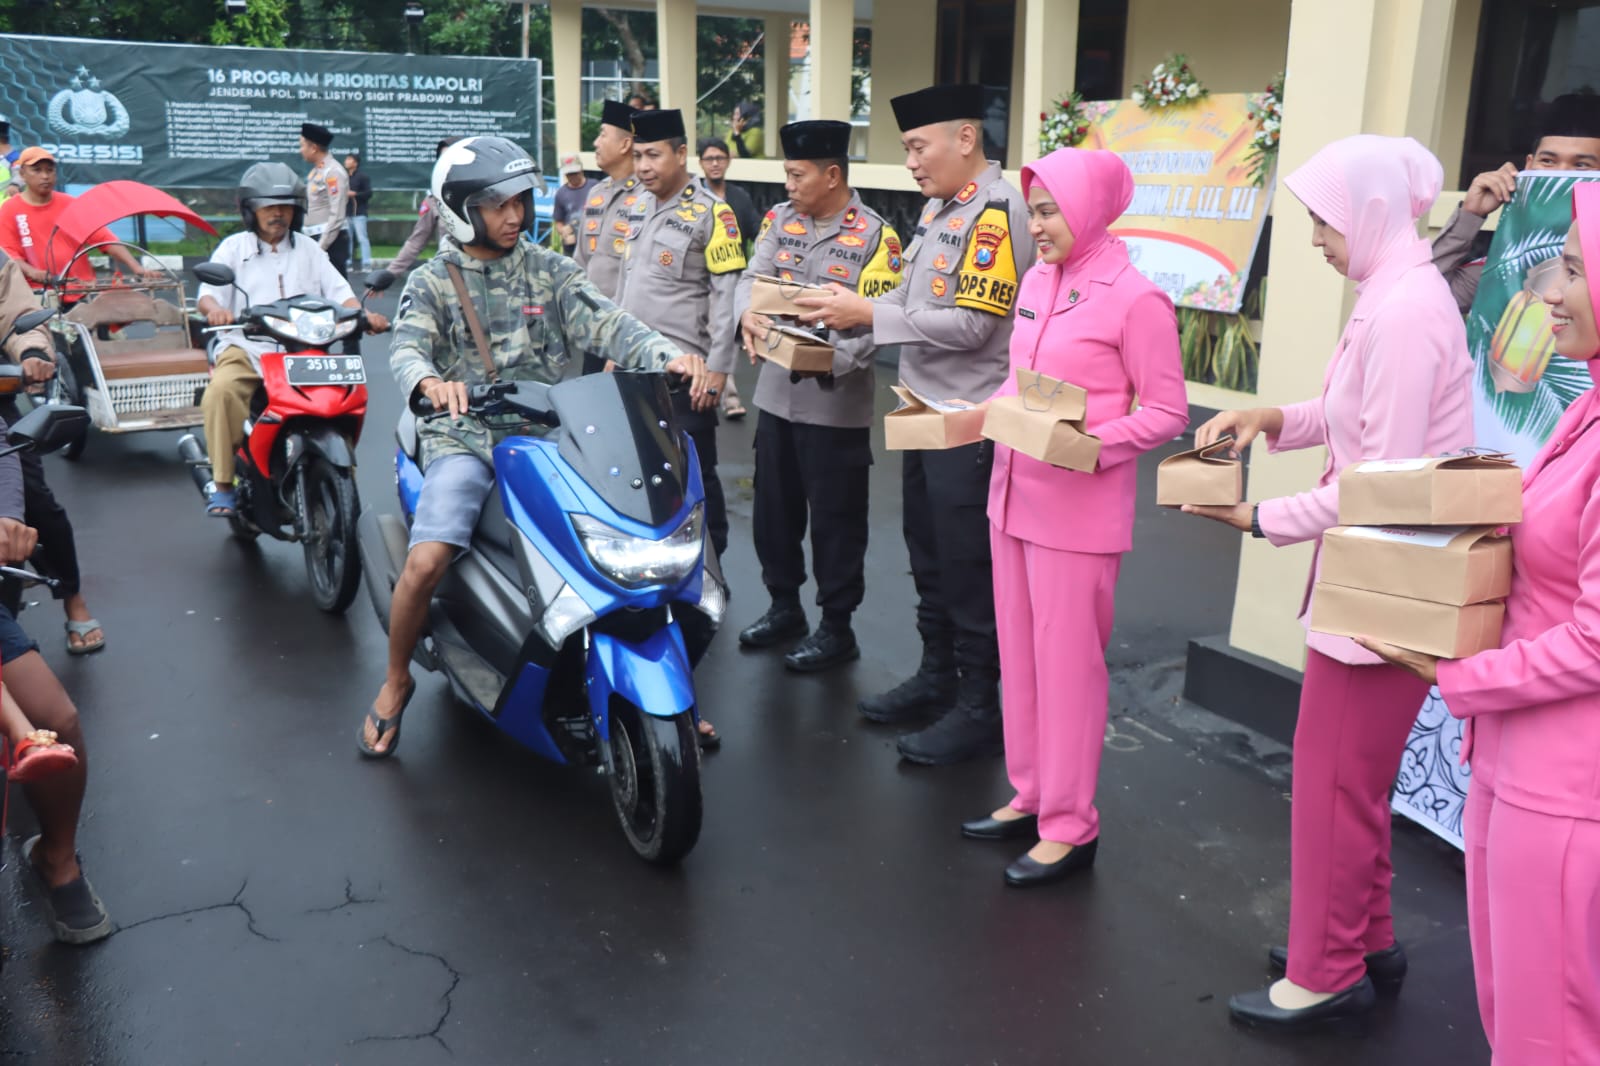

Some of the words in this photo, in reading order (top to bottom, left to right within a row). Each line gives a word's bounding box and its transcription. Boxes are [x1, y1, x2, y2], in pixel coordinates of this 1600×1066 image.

[207, 68, 226, 84] 16
[230, 70, 319, 86] PROGRAM
[324, 73, 409, 89] PRIORITAS
[413, 75, 483, 92] KAPOLRI
[209, 87, 267, 98] JENDERAL
[270, 88, 295, 99] POL.
[298, 90, 322, 100] Drs.
[325, 91, 363, 101] LISTYO
[365, 91, 395, 101] SIGIT
[397, 92, 455, 103] PRABOWO
[666, 218, 694, 235] POLRI
[938, 231, 962, 248] POLRI
[828, 247, 862, 263] POLRI
[988, 280, 1014, 306] RES
[287, 359, 294, 370] P
[306, 359, 337, 370] 3516
